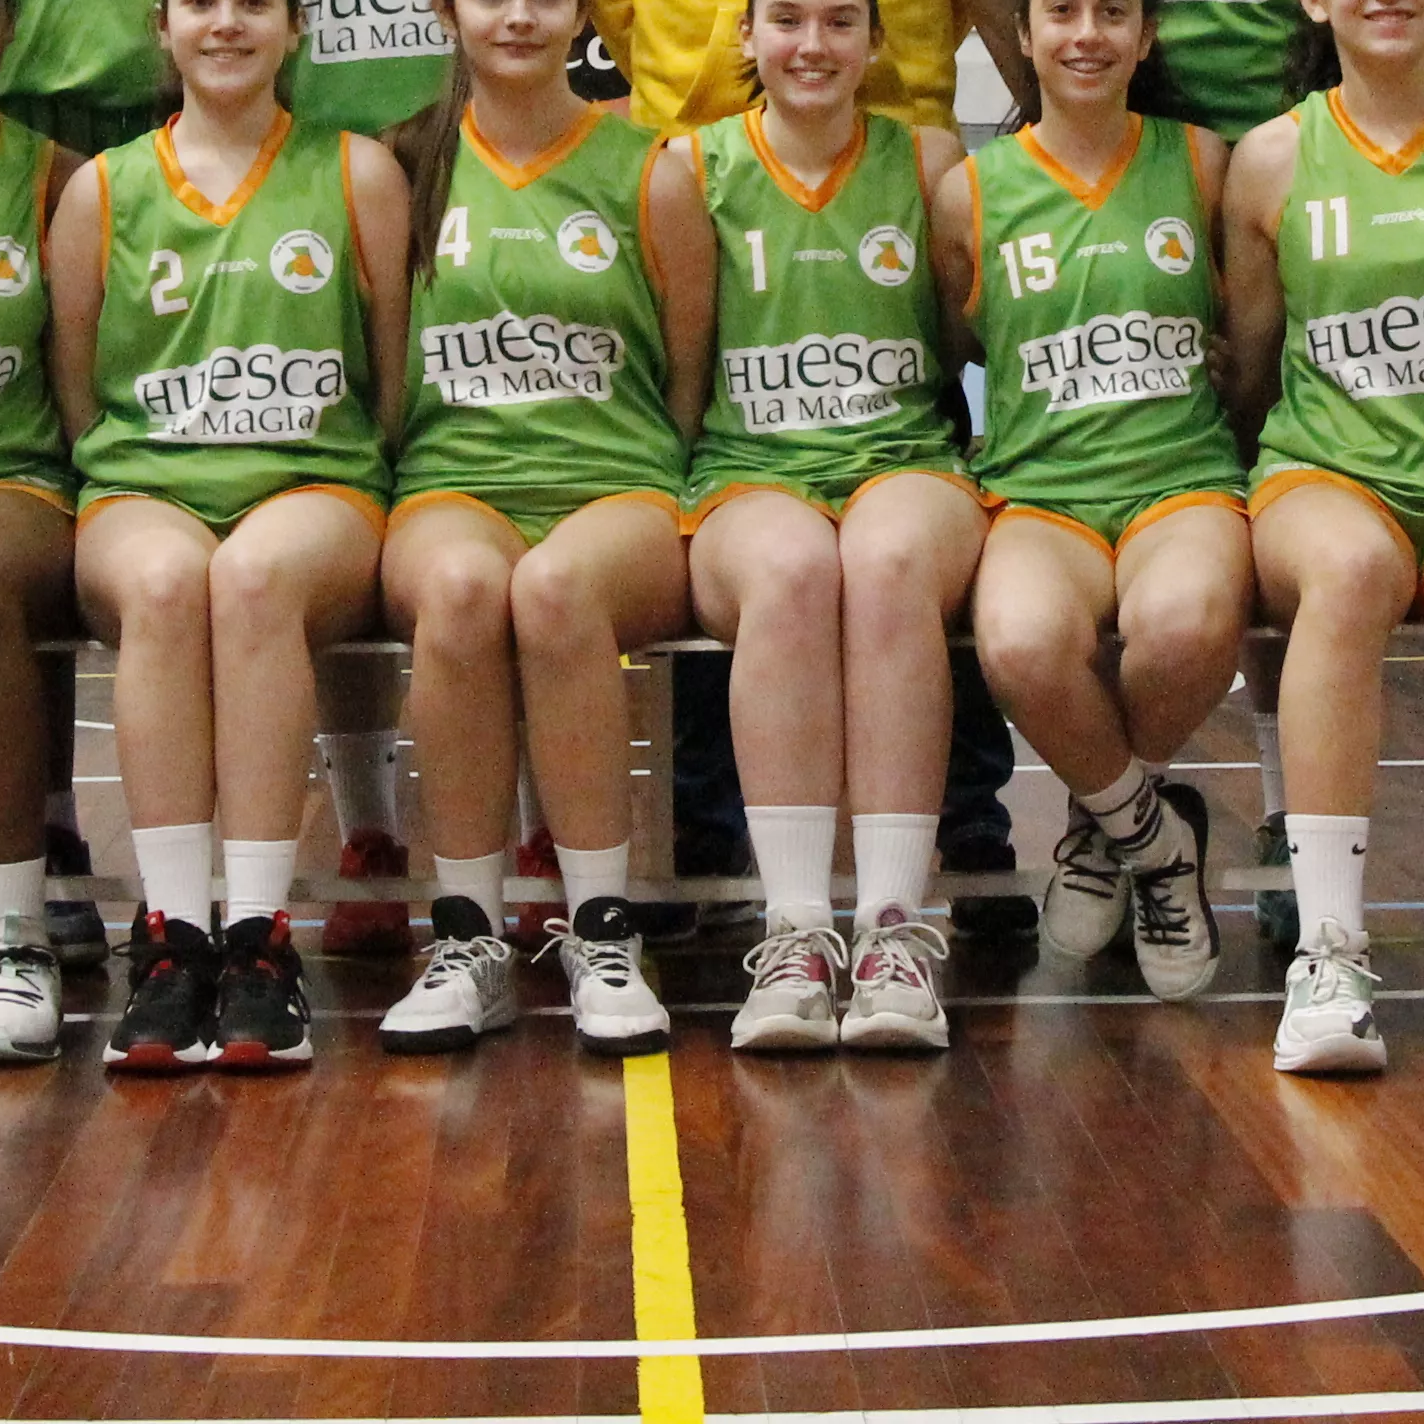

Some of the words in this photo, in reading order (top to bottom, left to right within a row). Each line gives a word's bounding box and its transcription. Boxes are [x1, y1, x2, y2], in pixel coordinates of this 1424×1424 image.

[318, 24, 355, 55] La
[436, 207, 471, 266] 4
[1305, 196, 1348, 260] 11
[149, 249, 190, 316] 2
[745, 230, 766, 292] 1
[998, 232, 1057, 299] 15
[424, 319, 618, 373] Huesca
[726, 342, 923, 394] Huesca
[1025, 319, 1198, 385] Huesca
[142, 353, 343, 415] Huesca
[448, 376, 490, 403] La
[1335, 365, 1375, 393] La
[751, 398, 785, 425] La
